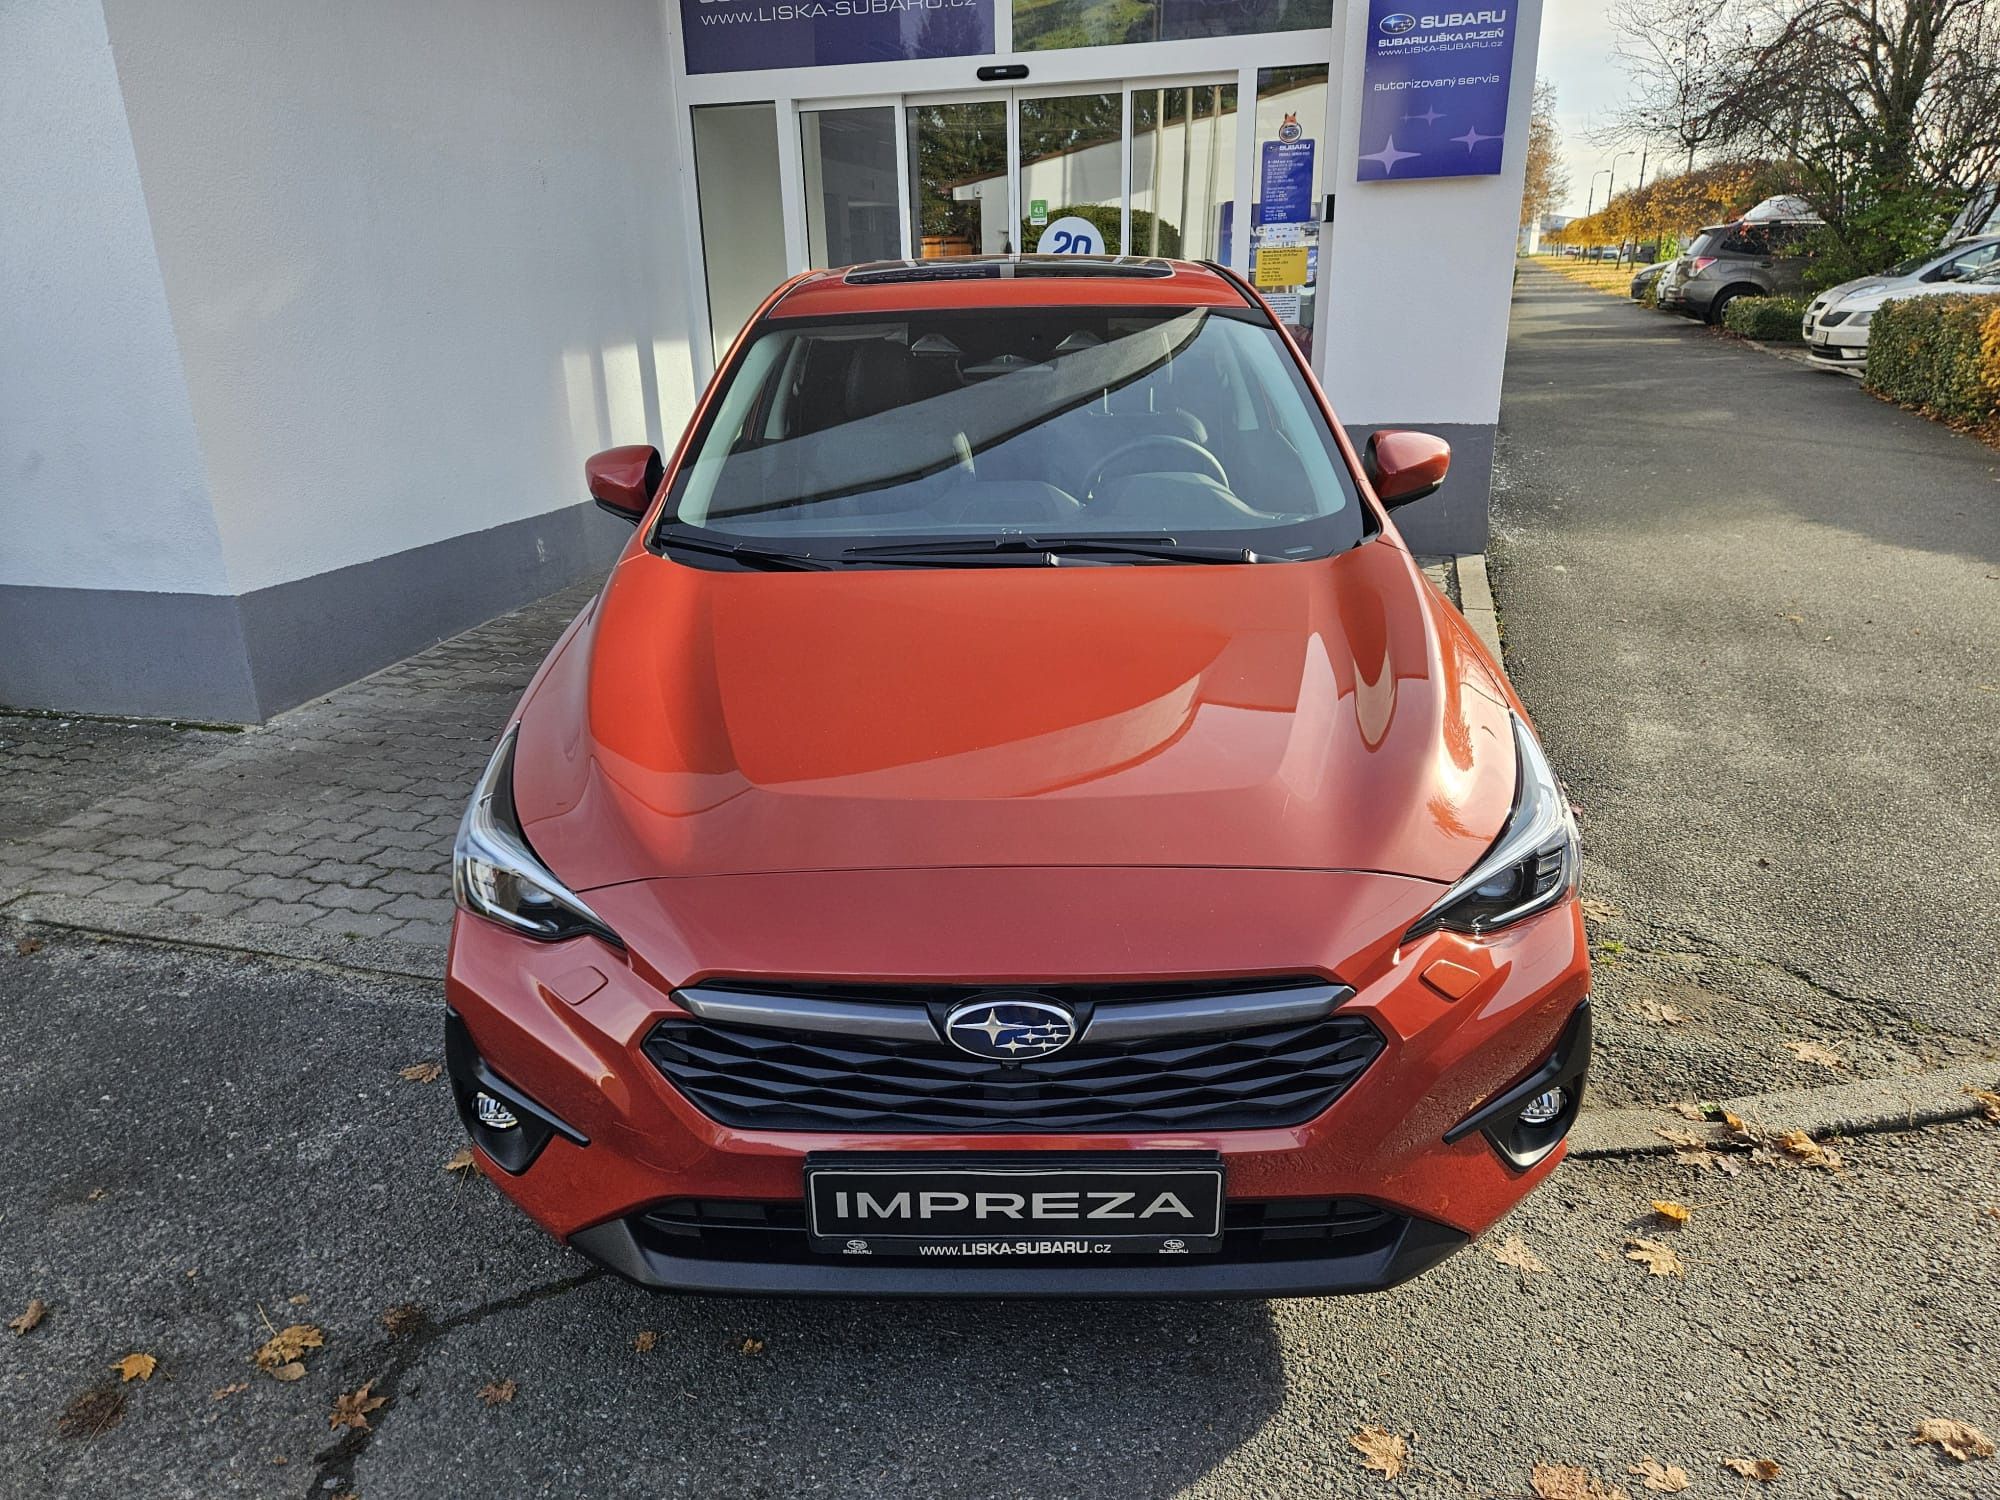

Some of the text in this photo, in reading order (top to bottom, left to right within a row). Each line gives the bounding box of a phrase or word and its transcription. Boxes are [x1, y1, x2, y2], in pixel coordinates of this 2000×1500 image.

[1420, 10, 1506, 29] SUBARU
[1378, 27, 1505, 48] SUBARU LIŠKA PLZEŇ
[1377, 41, 1503, 56] www.LISKA-SUBARU.cz
[1374, 73, 1500, 92] autorizovaný servis
[835, 1192, 1195, 1219] IMPREZA
[919, 1240, 1112, 1256] www.LISKA-SUBARU.cz
